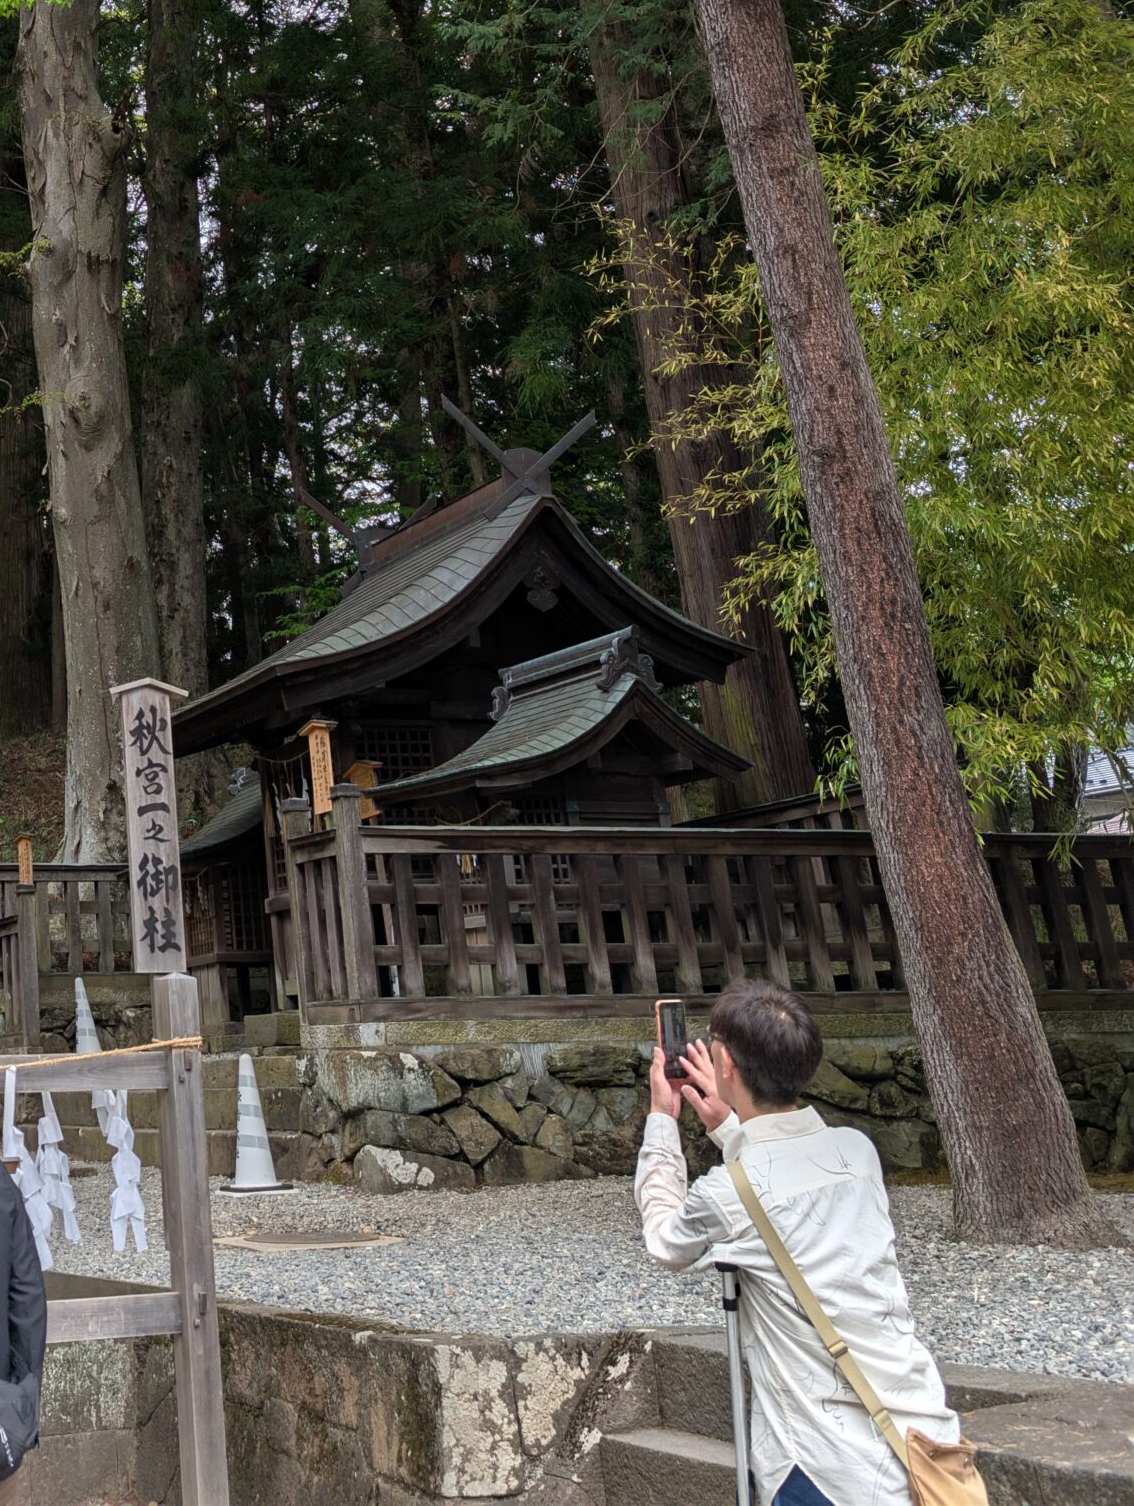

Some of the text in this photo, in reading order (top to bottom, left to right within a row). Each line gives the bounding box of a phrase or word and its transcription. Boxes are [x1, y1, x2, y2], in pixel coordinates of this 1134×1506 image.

[129, 704, 181, 954] 秋宮一之御柱
